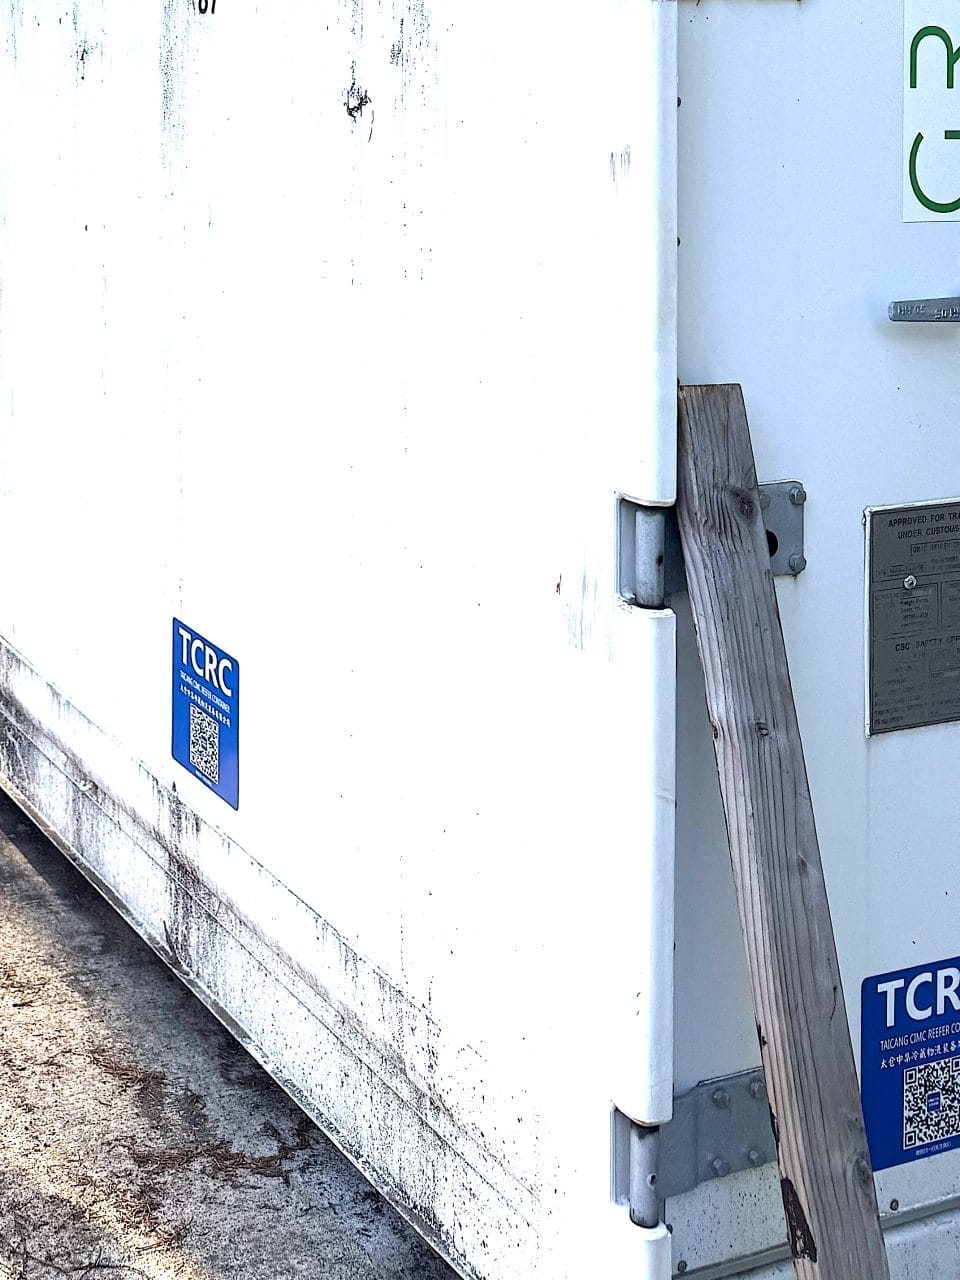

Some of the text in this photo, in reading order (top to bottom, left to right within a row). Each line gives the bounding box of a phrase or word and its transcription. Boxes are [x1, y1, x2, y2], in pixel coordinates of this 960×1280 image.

[888, 515, 927, 528] APPROVED
[930, 513, 945, 523] FOR
[897, 524, 959, 540] UNDER CUSTOMS
[895, 642, 911, 652] CSC
[916, 637, 943, 650] SAFY
[178, 626, 232, 697] TCRC
[877, 967, 960, 1027] TCR
[880, 1035, 909, 1052] TAICANG
[910, 1030, 927, 1044] CIMC
[927, 1025, 950, 1040] REEFER
